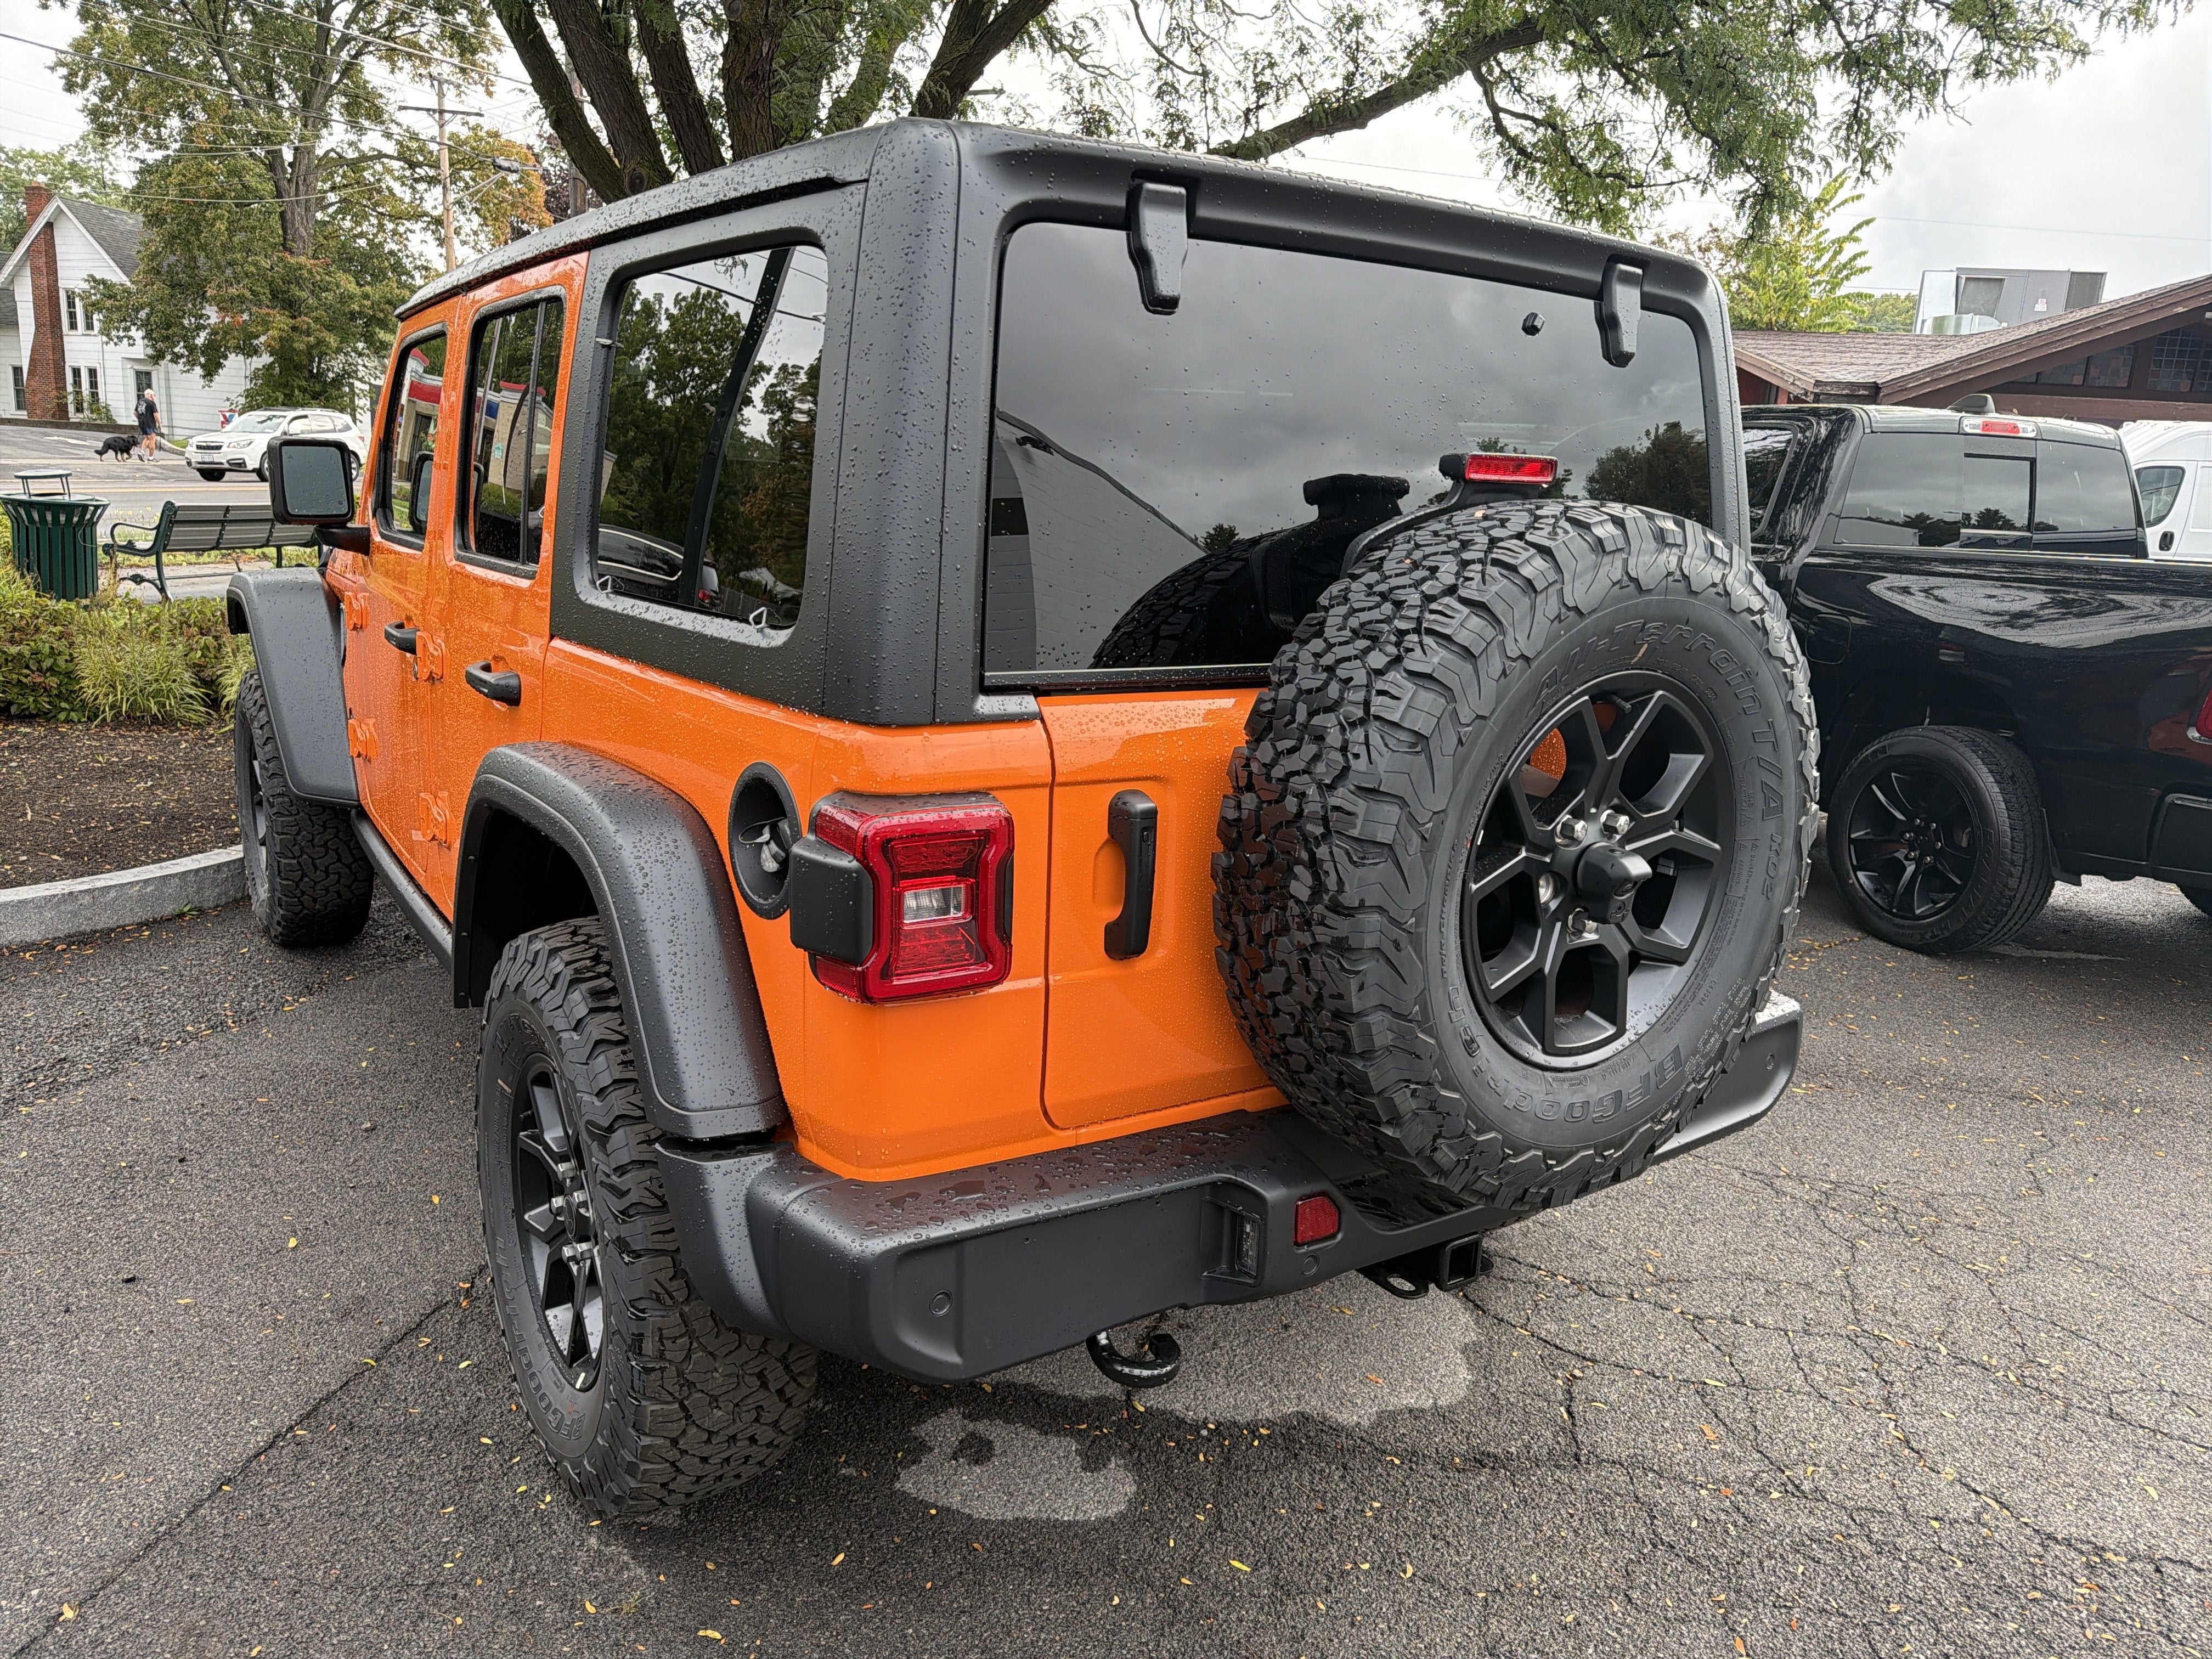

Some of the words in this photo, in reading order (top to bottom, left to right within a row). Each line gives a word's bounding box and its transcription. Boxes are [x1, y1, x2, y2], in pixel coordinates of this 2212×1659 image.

[1532, 618, 1762, 715] All-Terrain
[1752, 718, 1784, 821] T/A
[1761, 832, 1784, 900] KO2
[1449, 986, 1683, 1124] BFGoodrich
[495, 1233, 586, 1440] BFGoodrich
